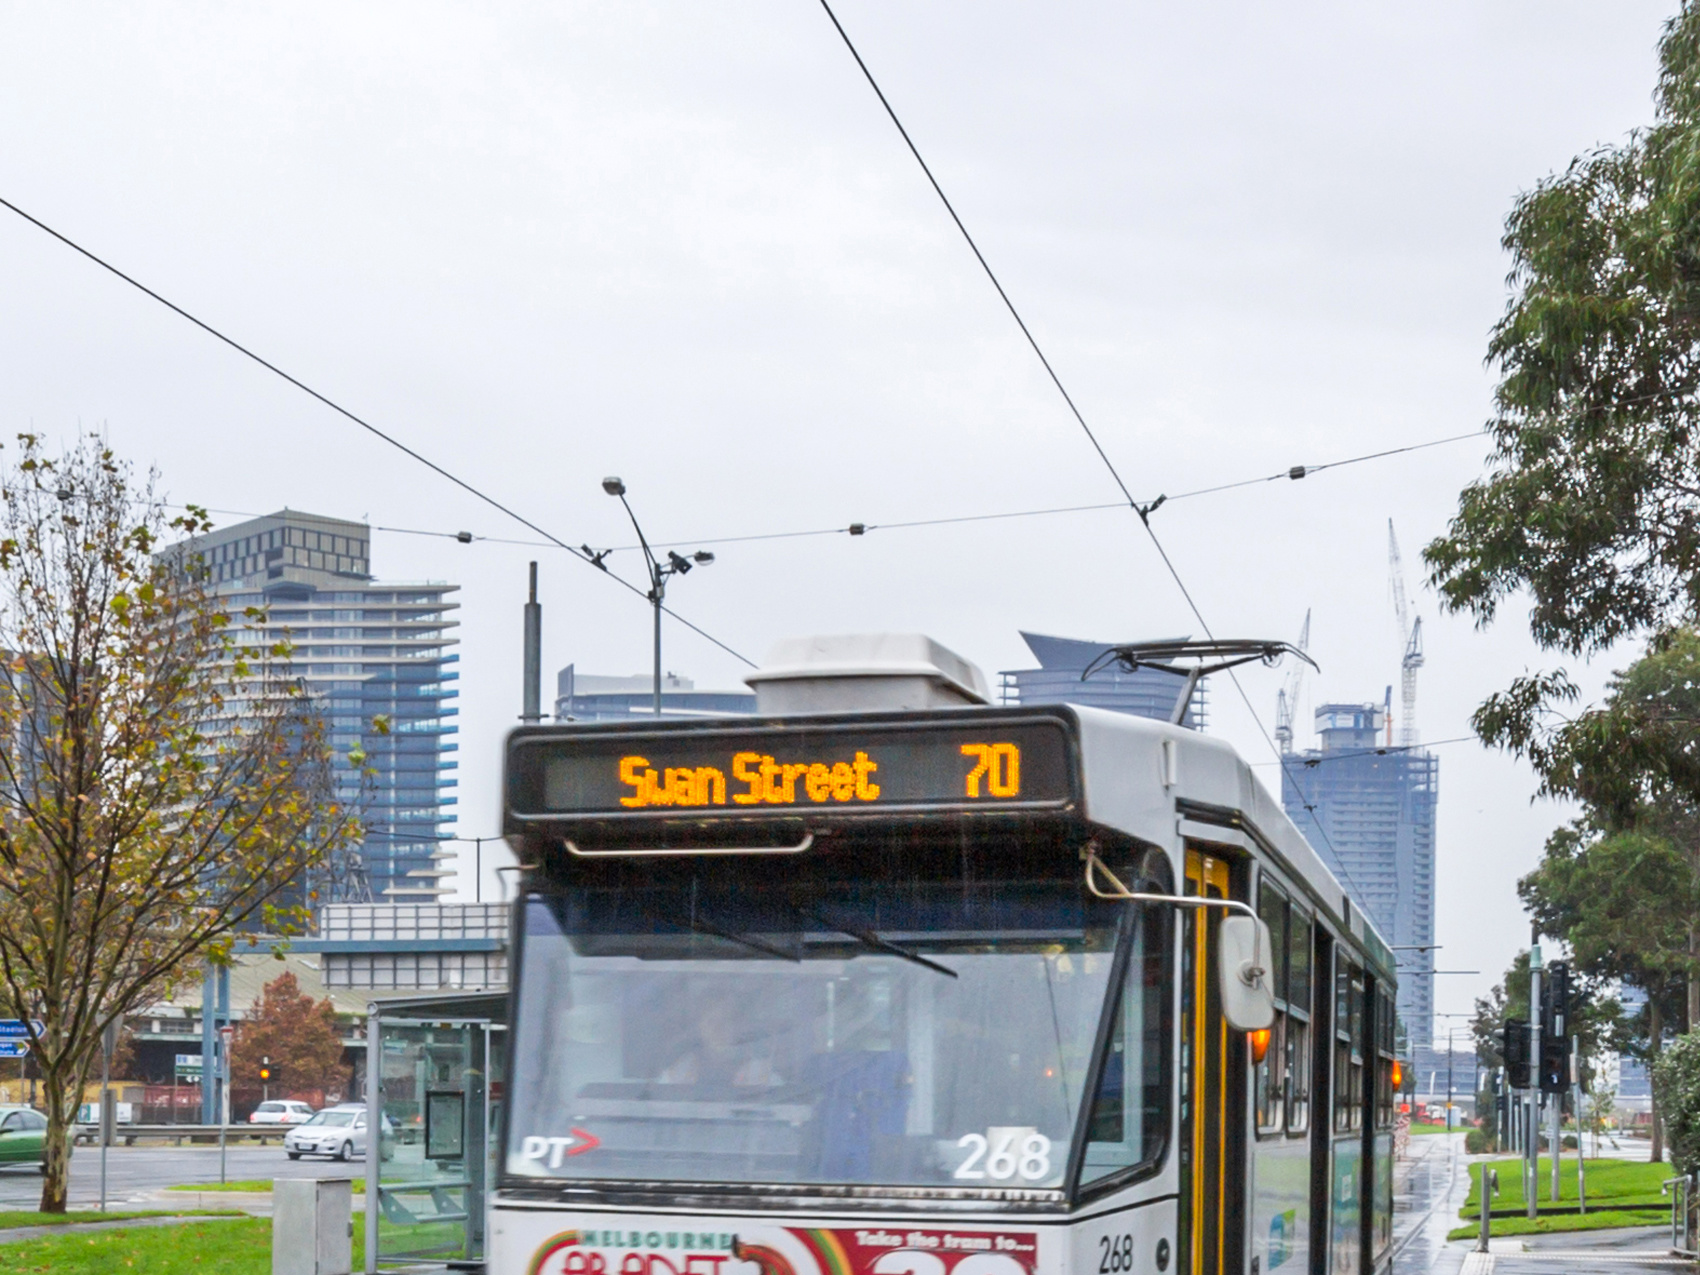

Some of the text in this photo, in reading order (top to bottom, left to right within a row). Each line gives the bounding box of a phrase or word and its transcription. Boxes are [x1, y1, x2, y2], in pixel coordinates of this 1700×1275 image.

[619, 743, 1021, 807] Swan Street 70
[953, 1132, 1050, 1181] 268
[581, 1229, 732, 1250] MELBOURNE
[855, 1231, 902, 1247] Take
[906, 1232, 940, 1248] the
[943, 1234, 992, 1250] tram
[1098, 1233, 1134, 1275] 268
